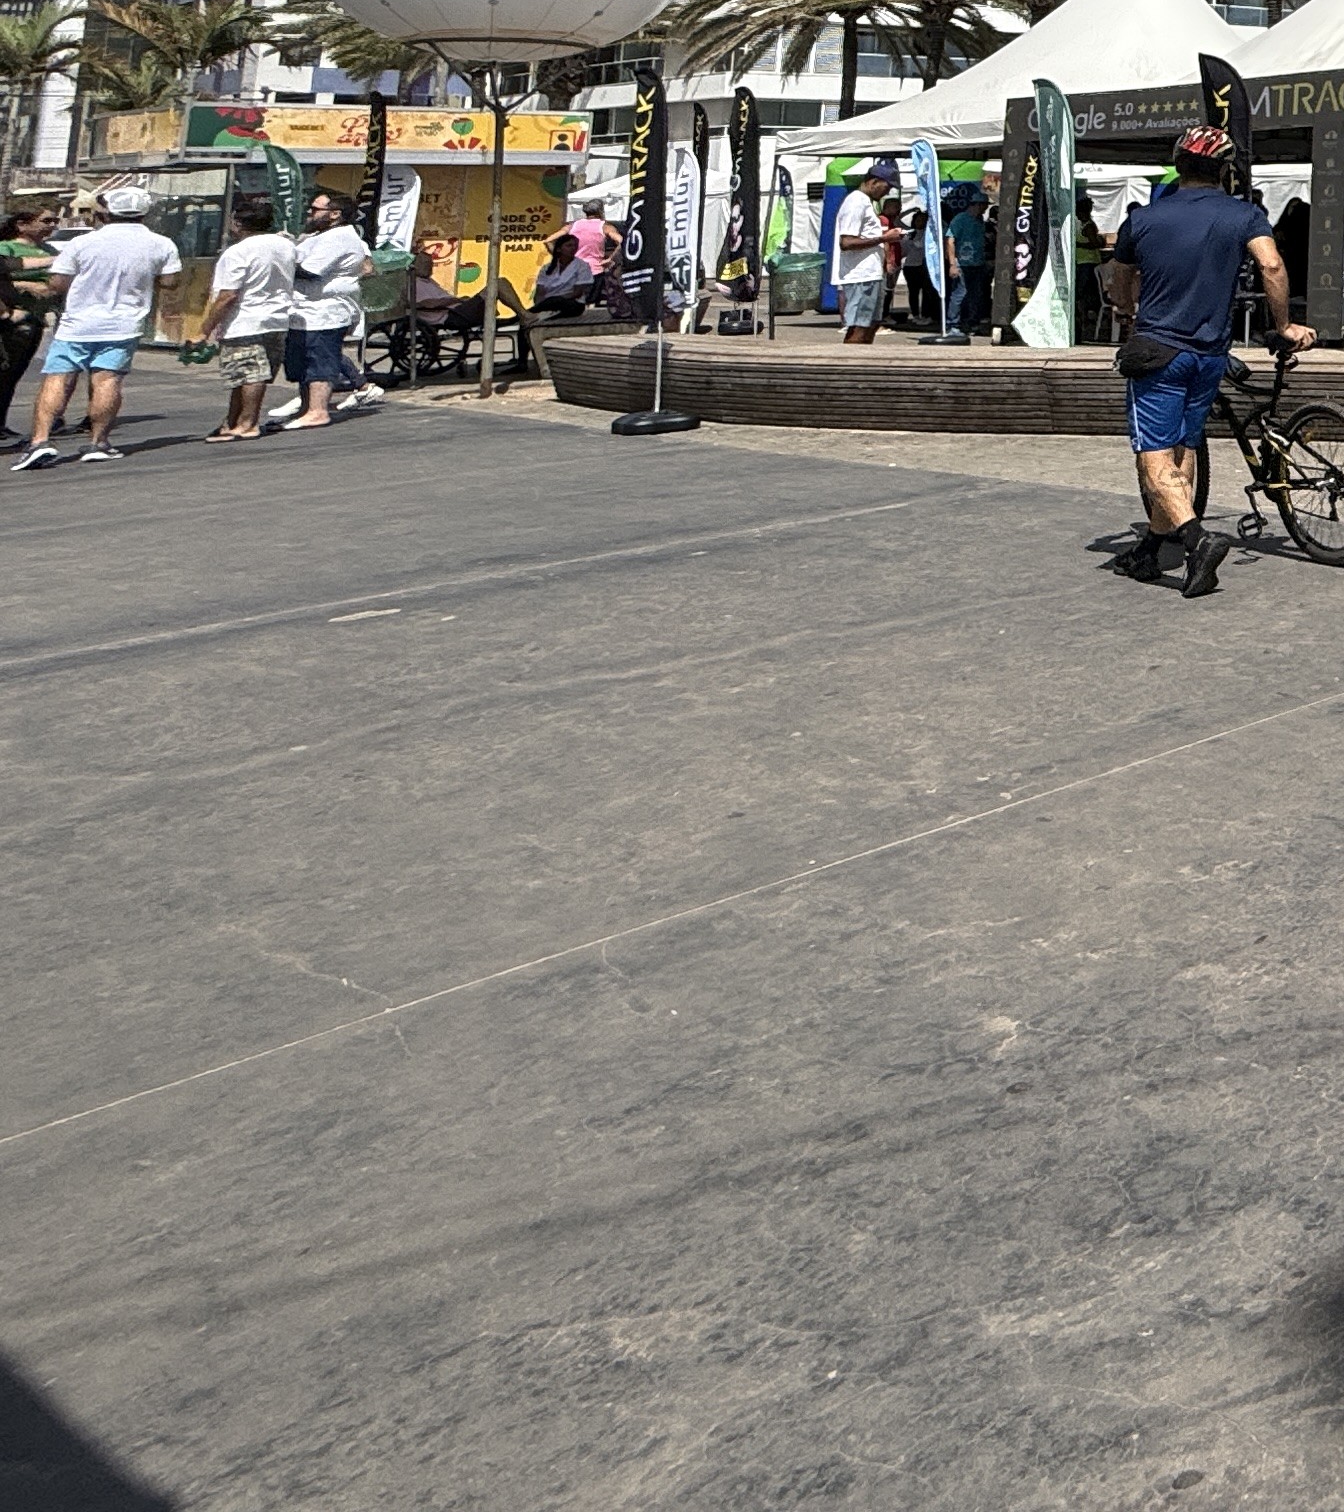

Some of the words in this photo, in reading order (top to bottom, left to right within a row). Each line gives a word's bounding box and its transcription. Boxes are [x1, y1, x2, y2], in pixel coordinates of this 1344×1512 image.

[1027, 104, 1107, 138] Ggle
[1114, 103, 1134, 116] 5.0
[1144, 117, 1201, 129] Avaliações
[626, 85, 657, 261] GMTRACK
[1016, 154, 1039, 233] GMTRACK
[670, 170, 691, 252] Emlur
[529, 214, 540, 223] O
[500, 222, 537, 233] ORRÓ
[475, 233, 548, 243] ENONTRA
[505, 244, 533, 253] MAR
